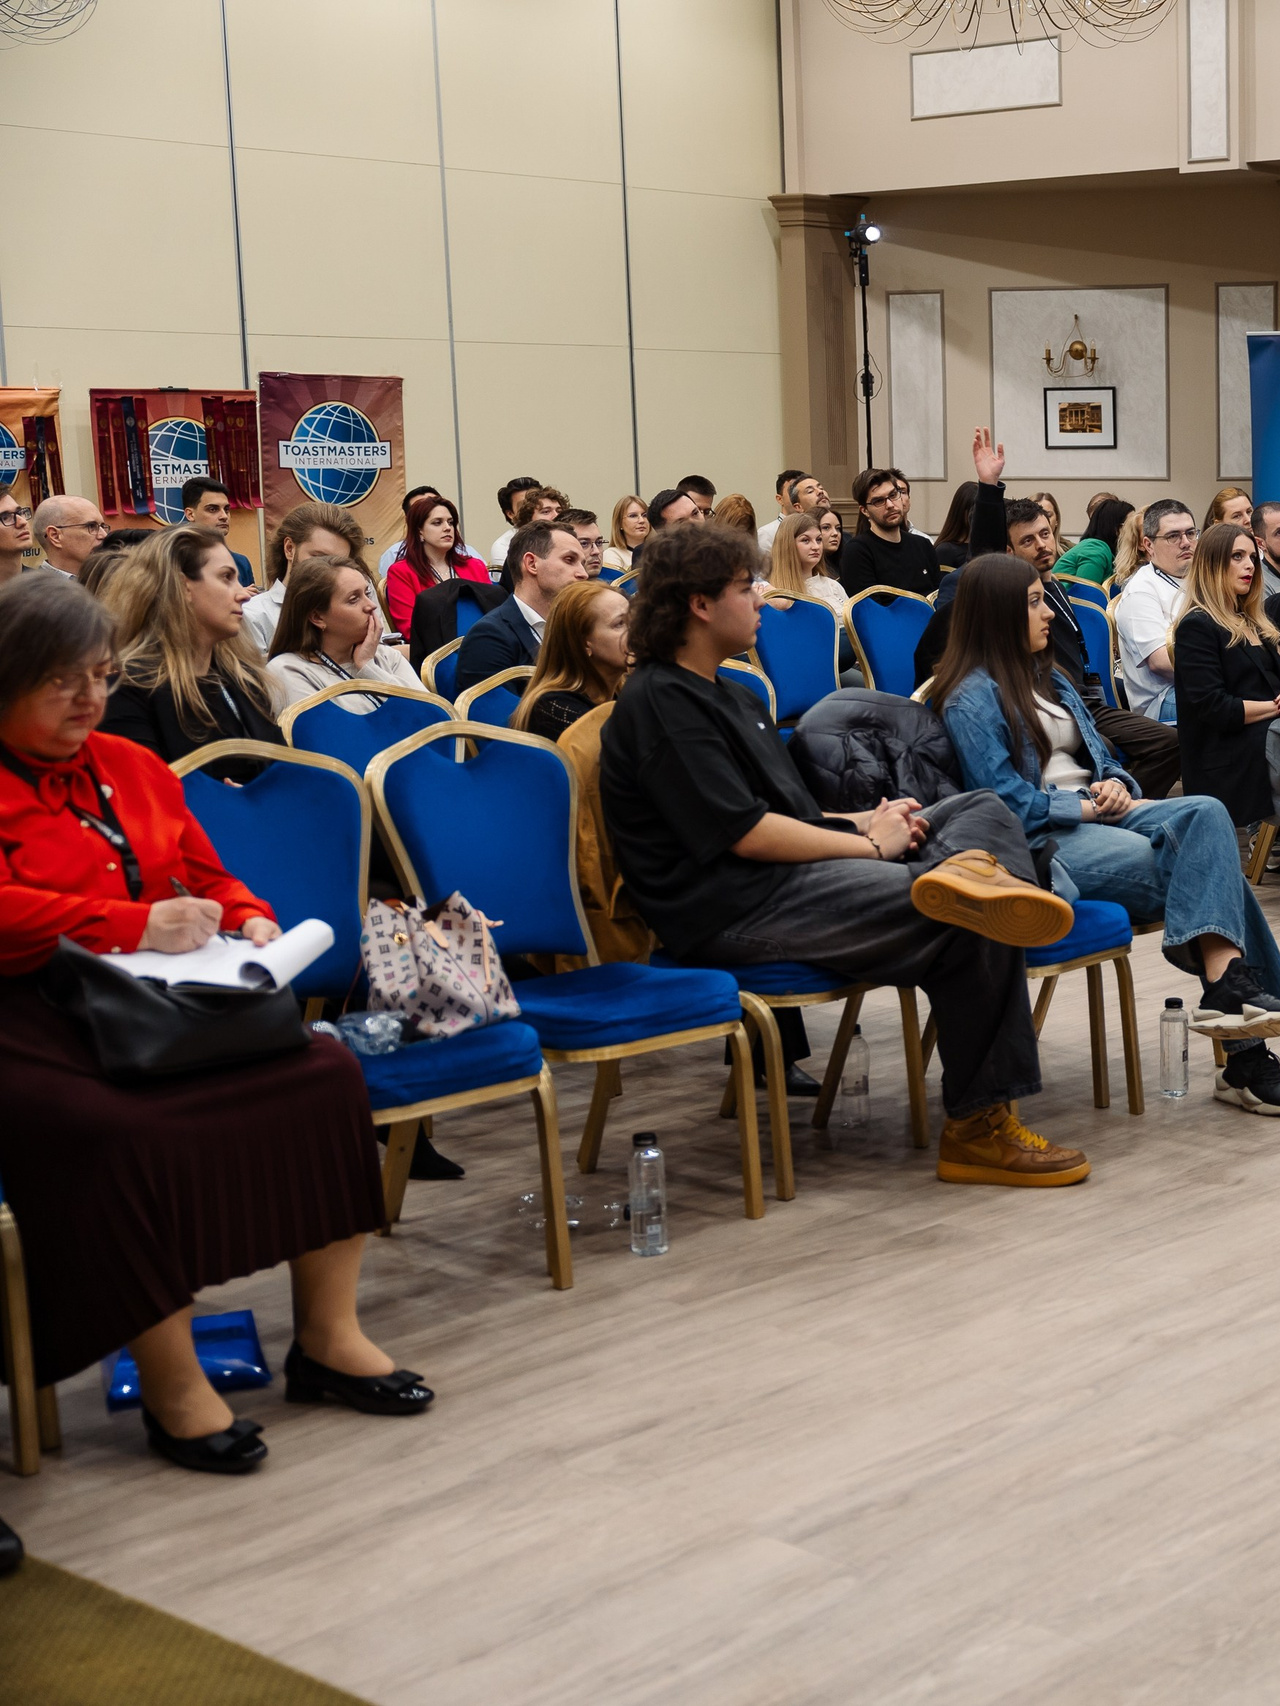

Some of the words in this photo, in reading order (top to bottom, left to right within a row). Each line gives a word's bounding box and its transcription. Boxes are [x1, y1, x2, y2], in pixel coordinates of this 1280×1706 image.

[283, 444, 387, 456] TOASTMASTERS
[154, 464, 209, 475] STMAST
[23, 548, 40, 557] IBIU
